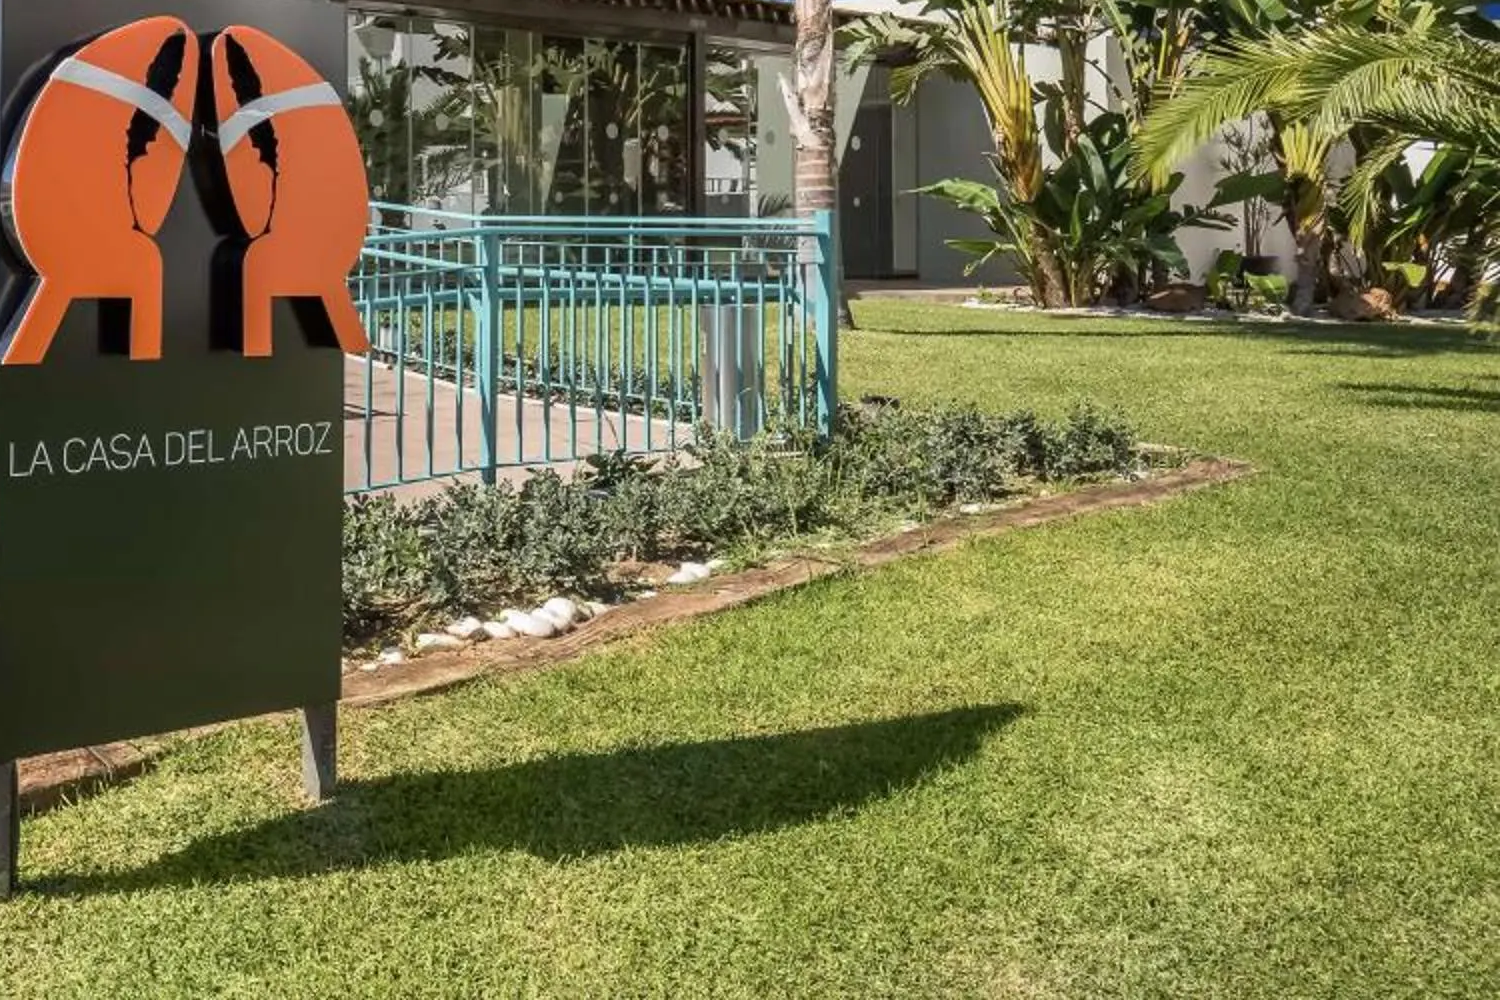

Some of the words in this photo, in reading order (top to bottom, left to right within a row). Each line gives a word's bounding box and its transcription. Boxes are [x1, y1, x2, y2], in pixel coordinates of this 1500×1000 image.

[8, 440, 55, 478] LA
[62, 433, 156, 475] CASA
[165, 429, 225, 466] DEL
[231, 421, 333, 461] ARROZ
